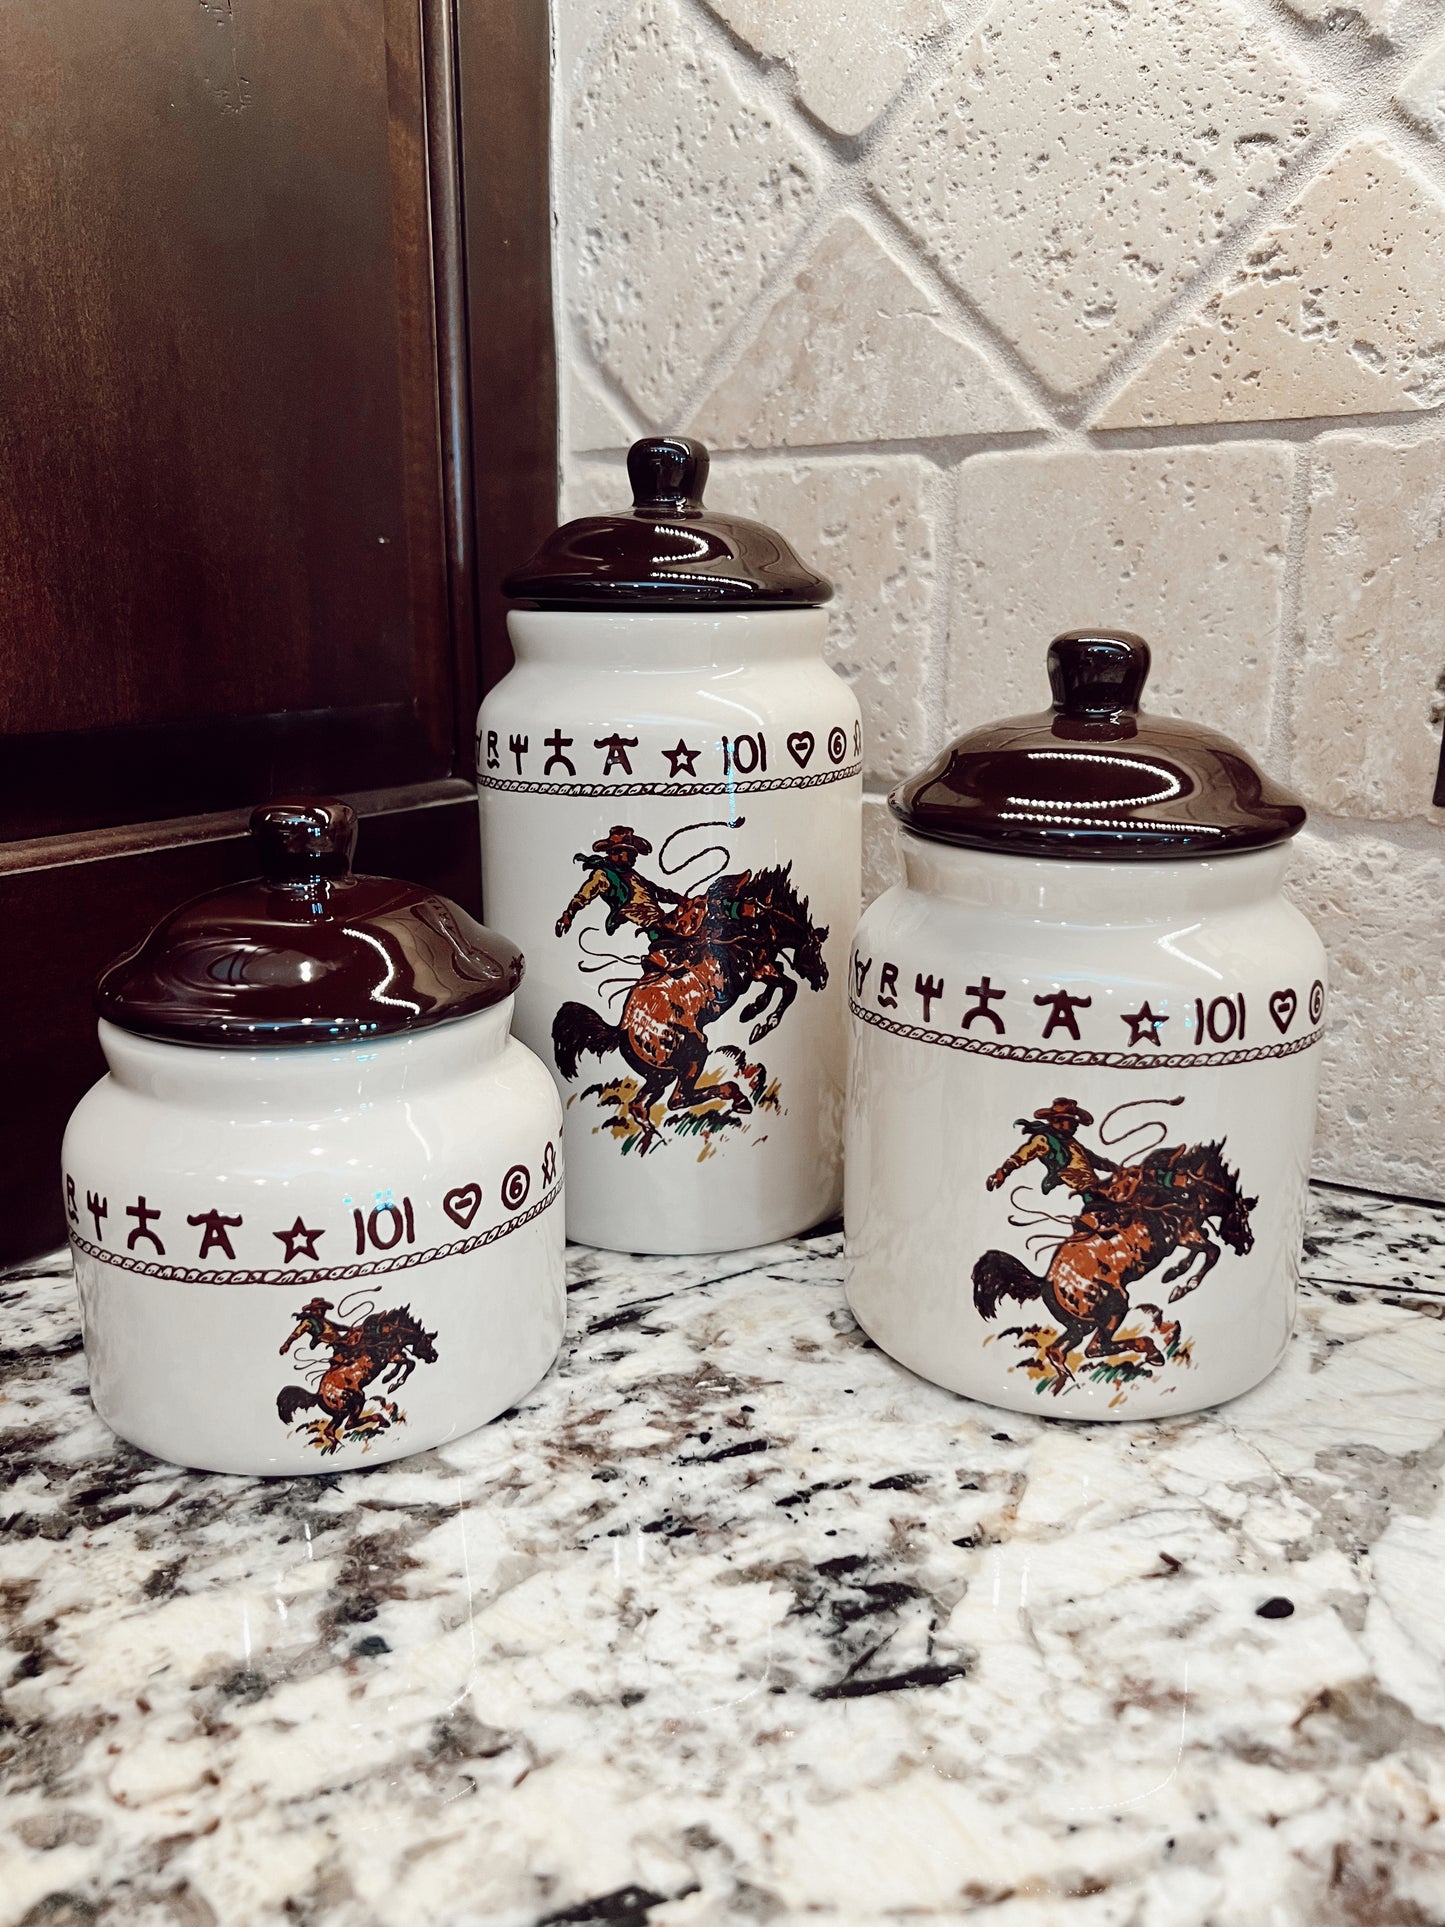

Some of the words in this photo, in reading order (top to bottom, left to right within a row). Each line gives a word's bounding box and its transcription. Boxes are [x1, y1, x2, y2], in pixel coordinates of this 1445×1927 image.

[722, 733, 767, 776] 101
[1195, 992, 1245, 1045] 101
[354, 1197, 415, 1255] 101
